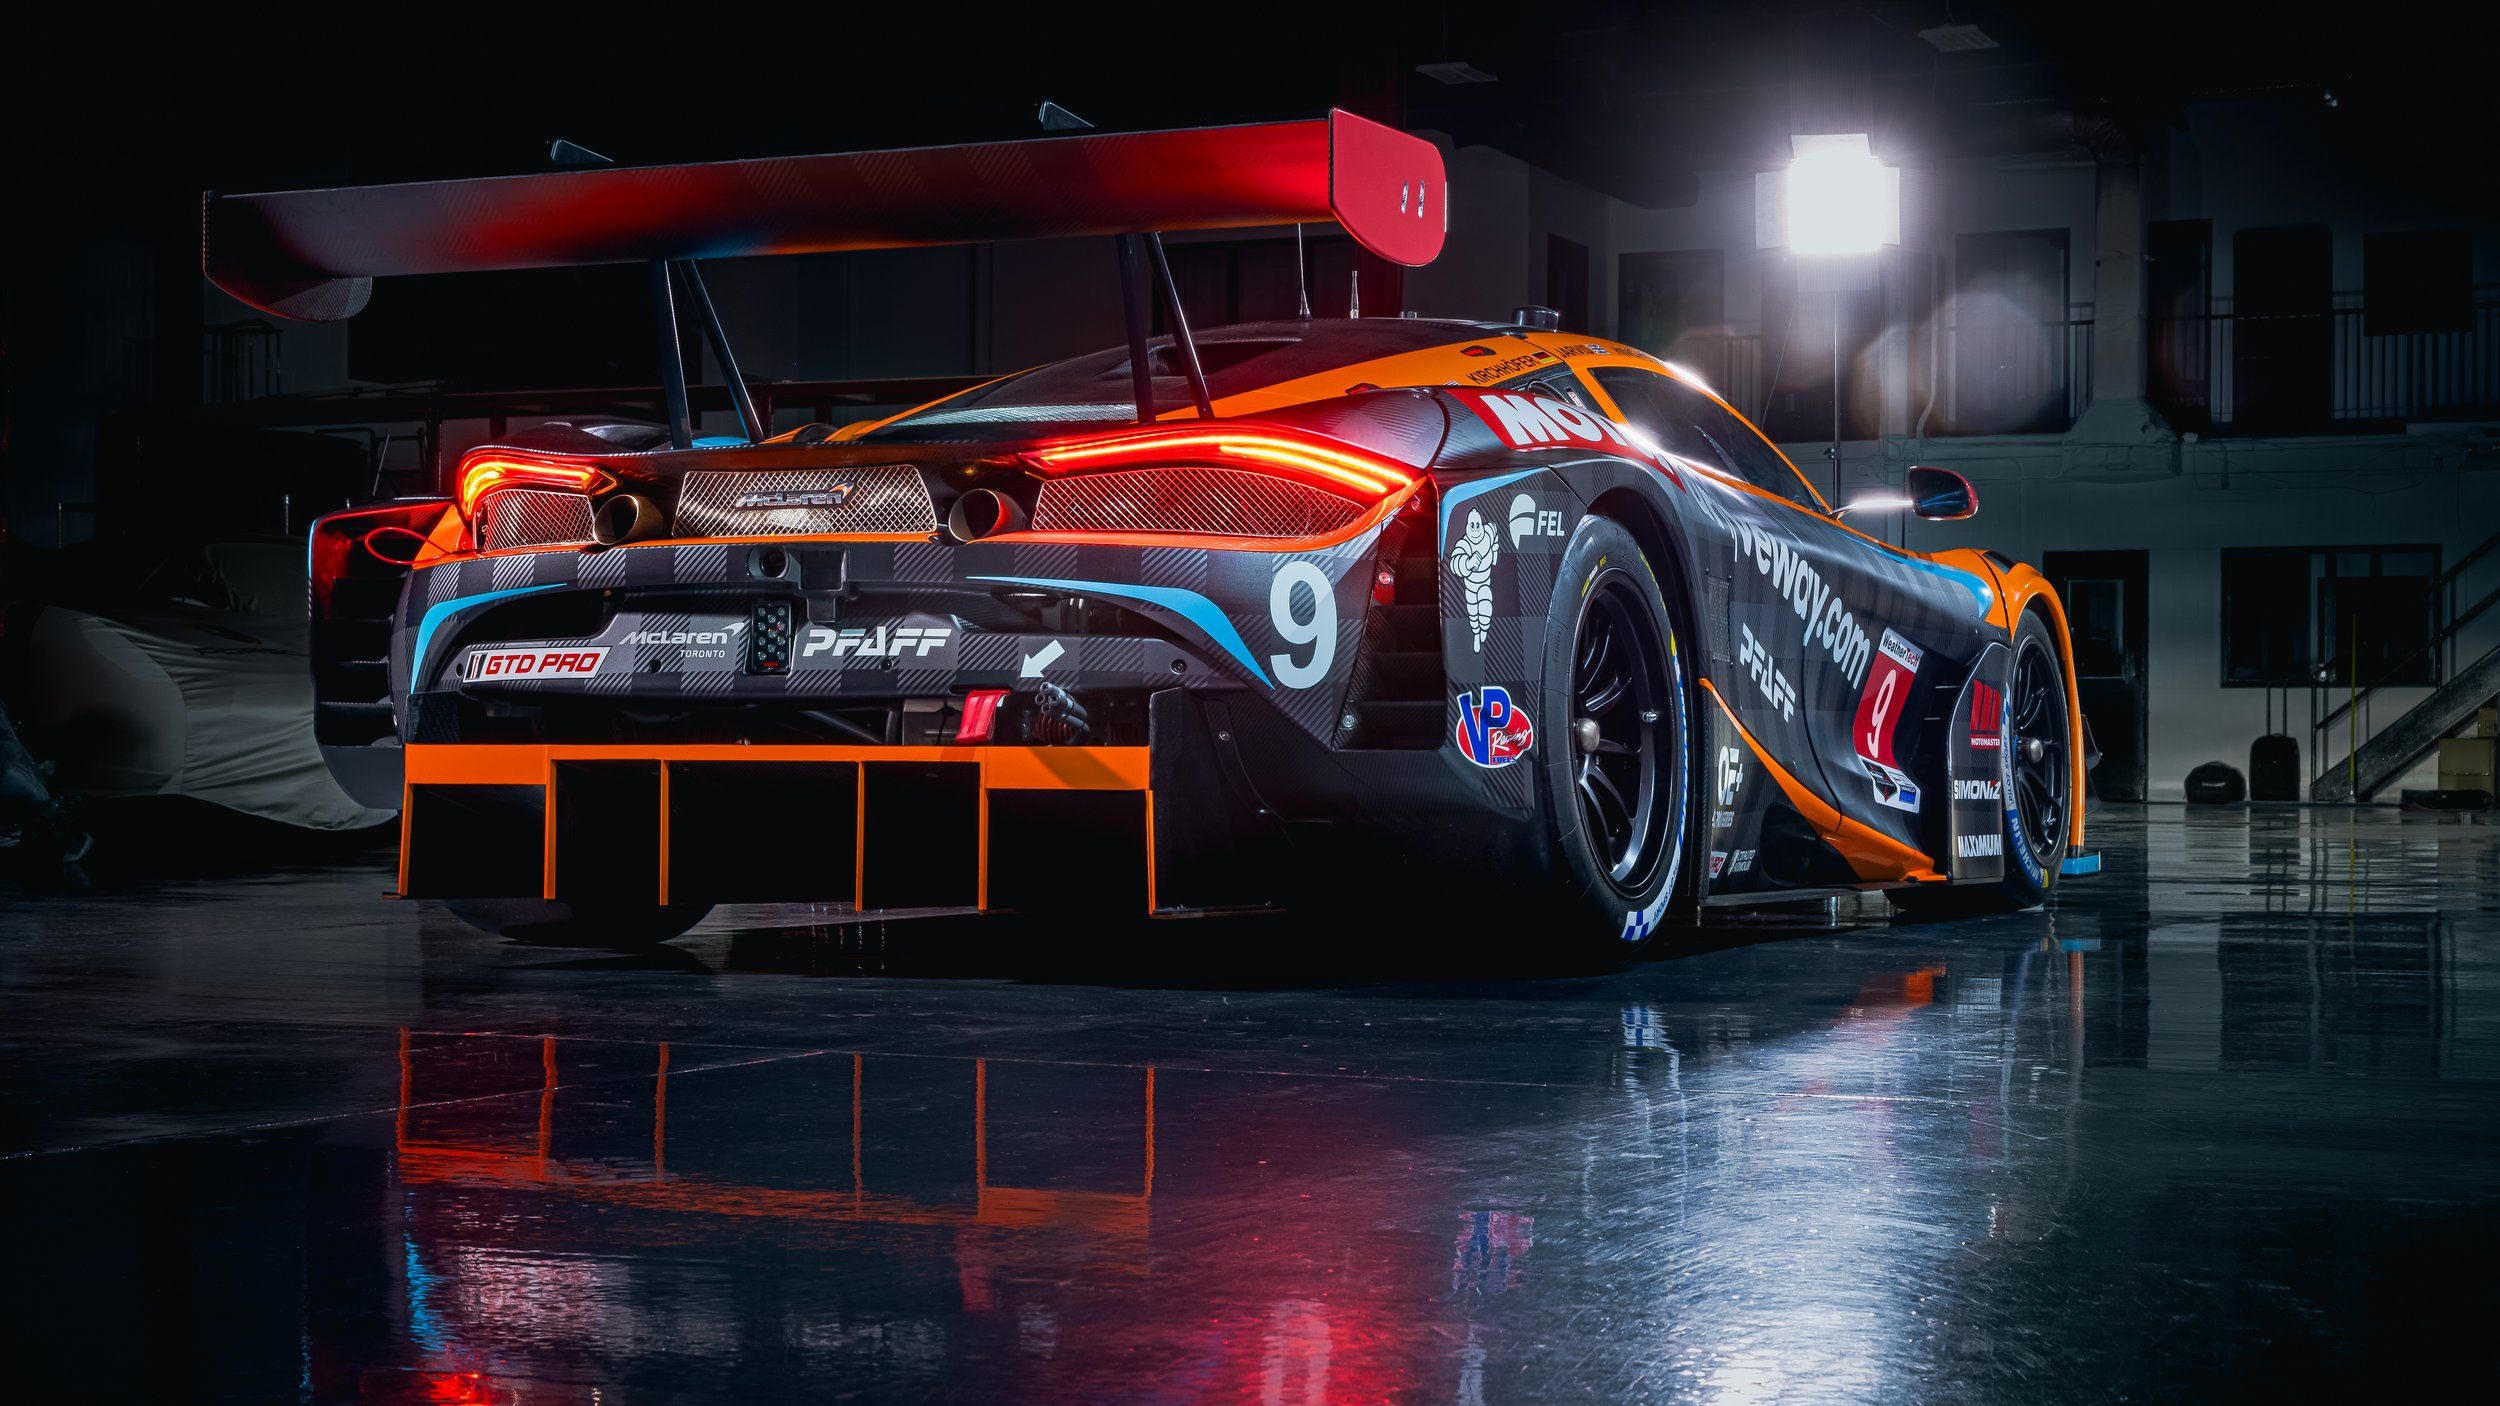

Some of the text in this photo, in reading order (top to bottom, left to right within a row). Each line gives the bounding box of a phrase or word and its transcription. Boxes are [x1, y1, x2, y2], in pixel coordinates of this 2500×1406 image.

[1466, 355, 1541, 384] KIRCHHÖFER
[736, 492, 842, 507] McLaren
[1537, 510, 1565, 536] FEL
[619, 630, 727, 645] McLaren
[1270, 561, 1338, 688] 9
[680, 649, 725, 658] TORONTO
[802, 626, 952, 656] PFAFF
[485, 653, 600, 675] GTD PRO
[1740, 622, 1796, 723] PFAFF
[1457, 686, 1512, 765] VP
[1867, 669, 1897, 758] 9
[1491, 729, 1531, 755] Racing
[1958, 834, 2002, 858] MAXIMUM
[2011, 817, 2041, 882] MICHELIN
